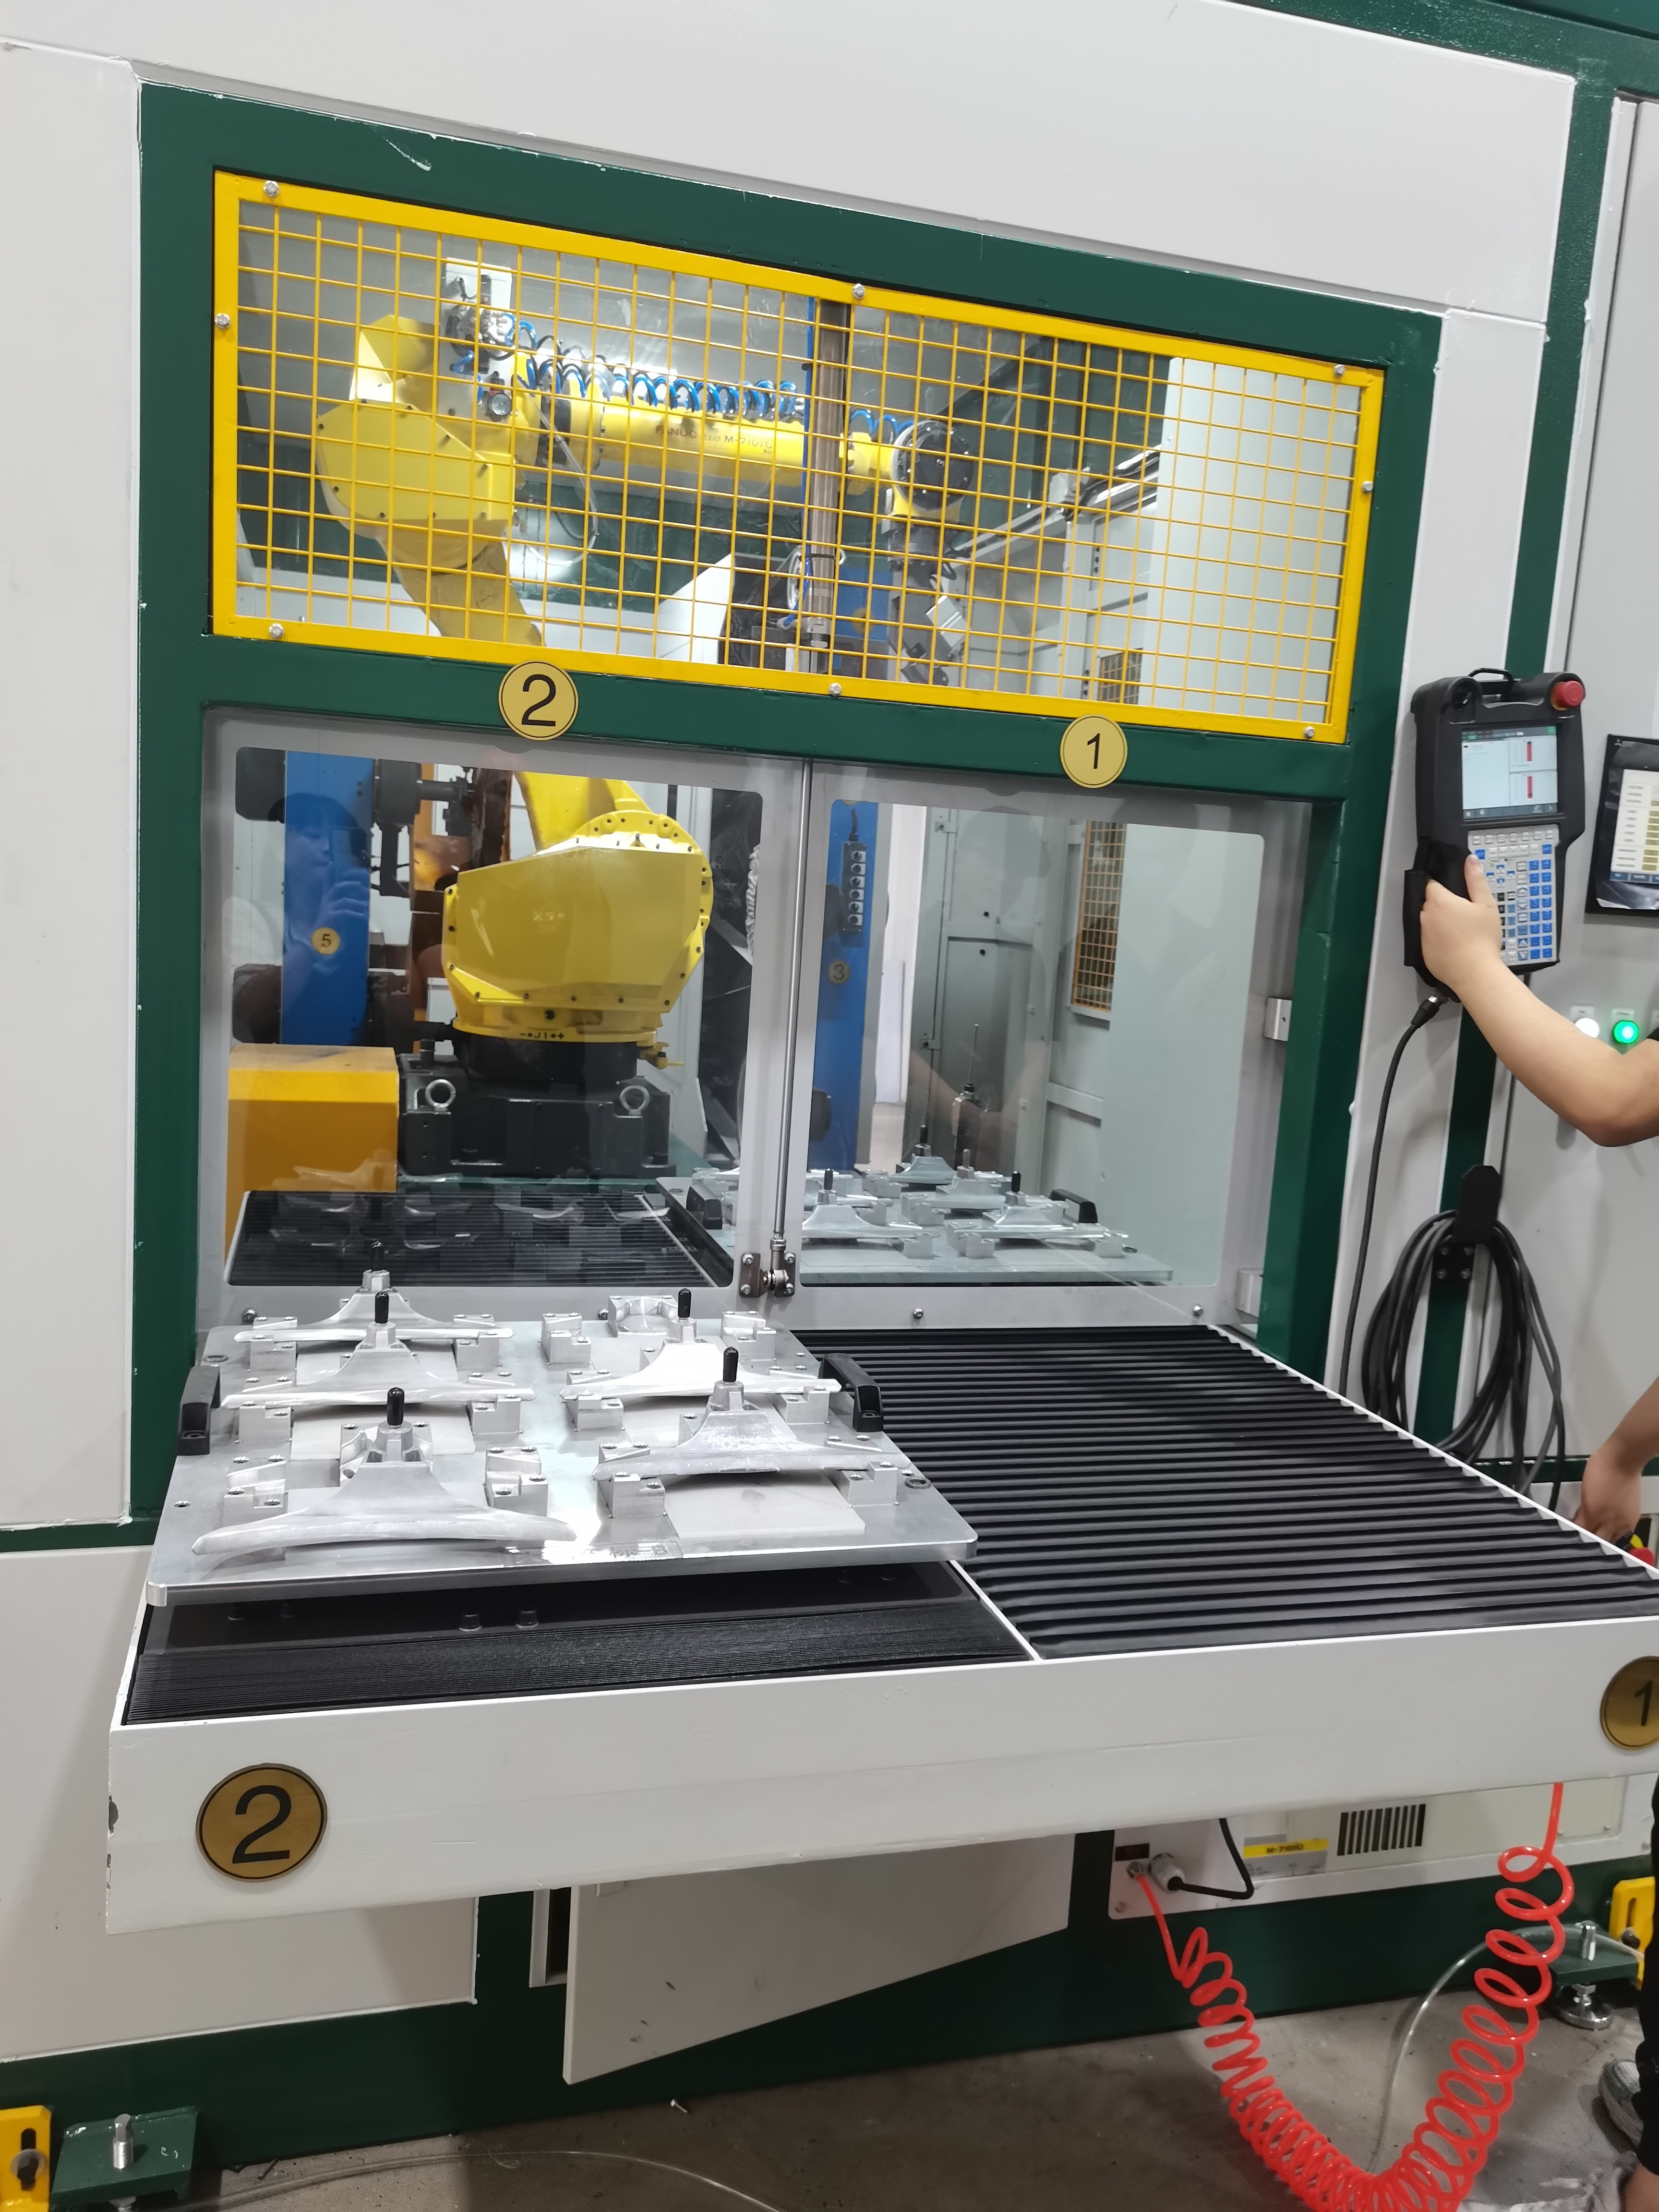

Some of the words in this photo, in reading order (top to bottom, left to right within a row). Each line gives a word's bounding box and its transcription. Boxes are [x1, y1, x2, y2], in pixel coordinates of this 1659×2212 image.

[522, 674, 556, 726] 2
[1087, 733, 1100, 769] 1
[322, 934, 331, 948] 5
[833, 964, 845, 980] 3
[1635, 1680, 1652, 1726] 1
[232, 1785, 292, 1863] 2
